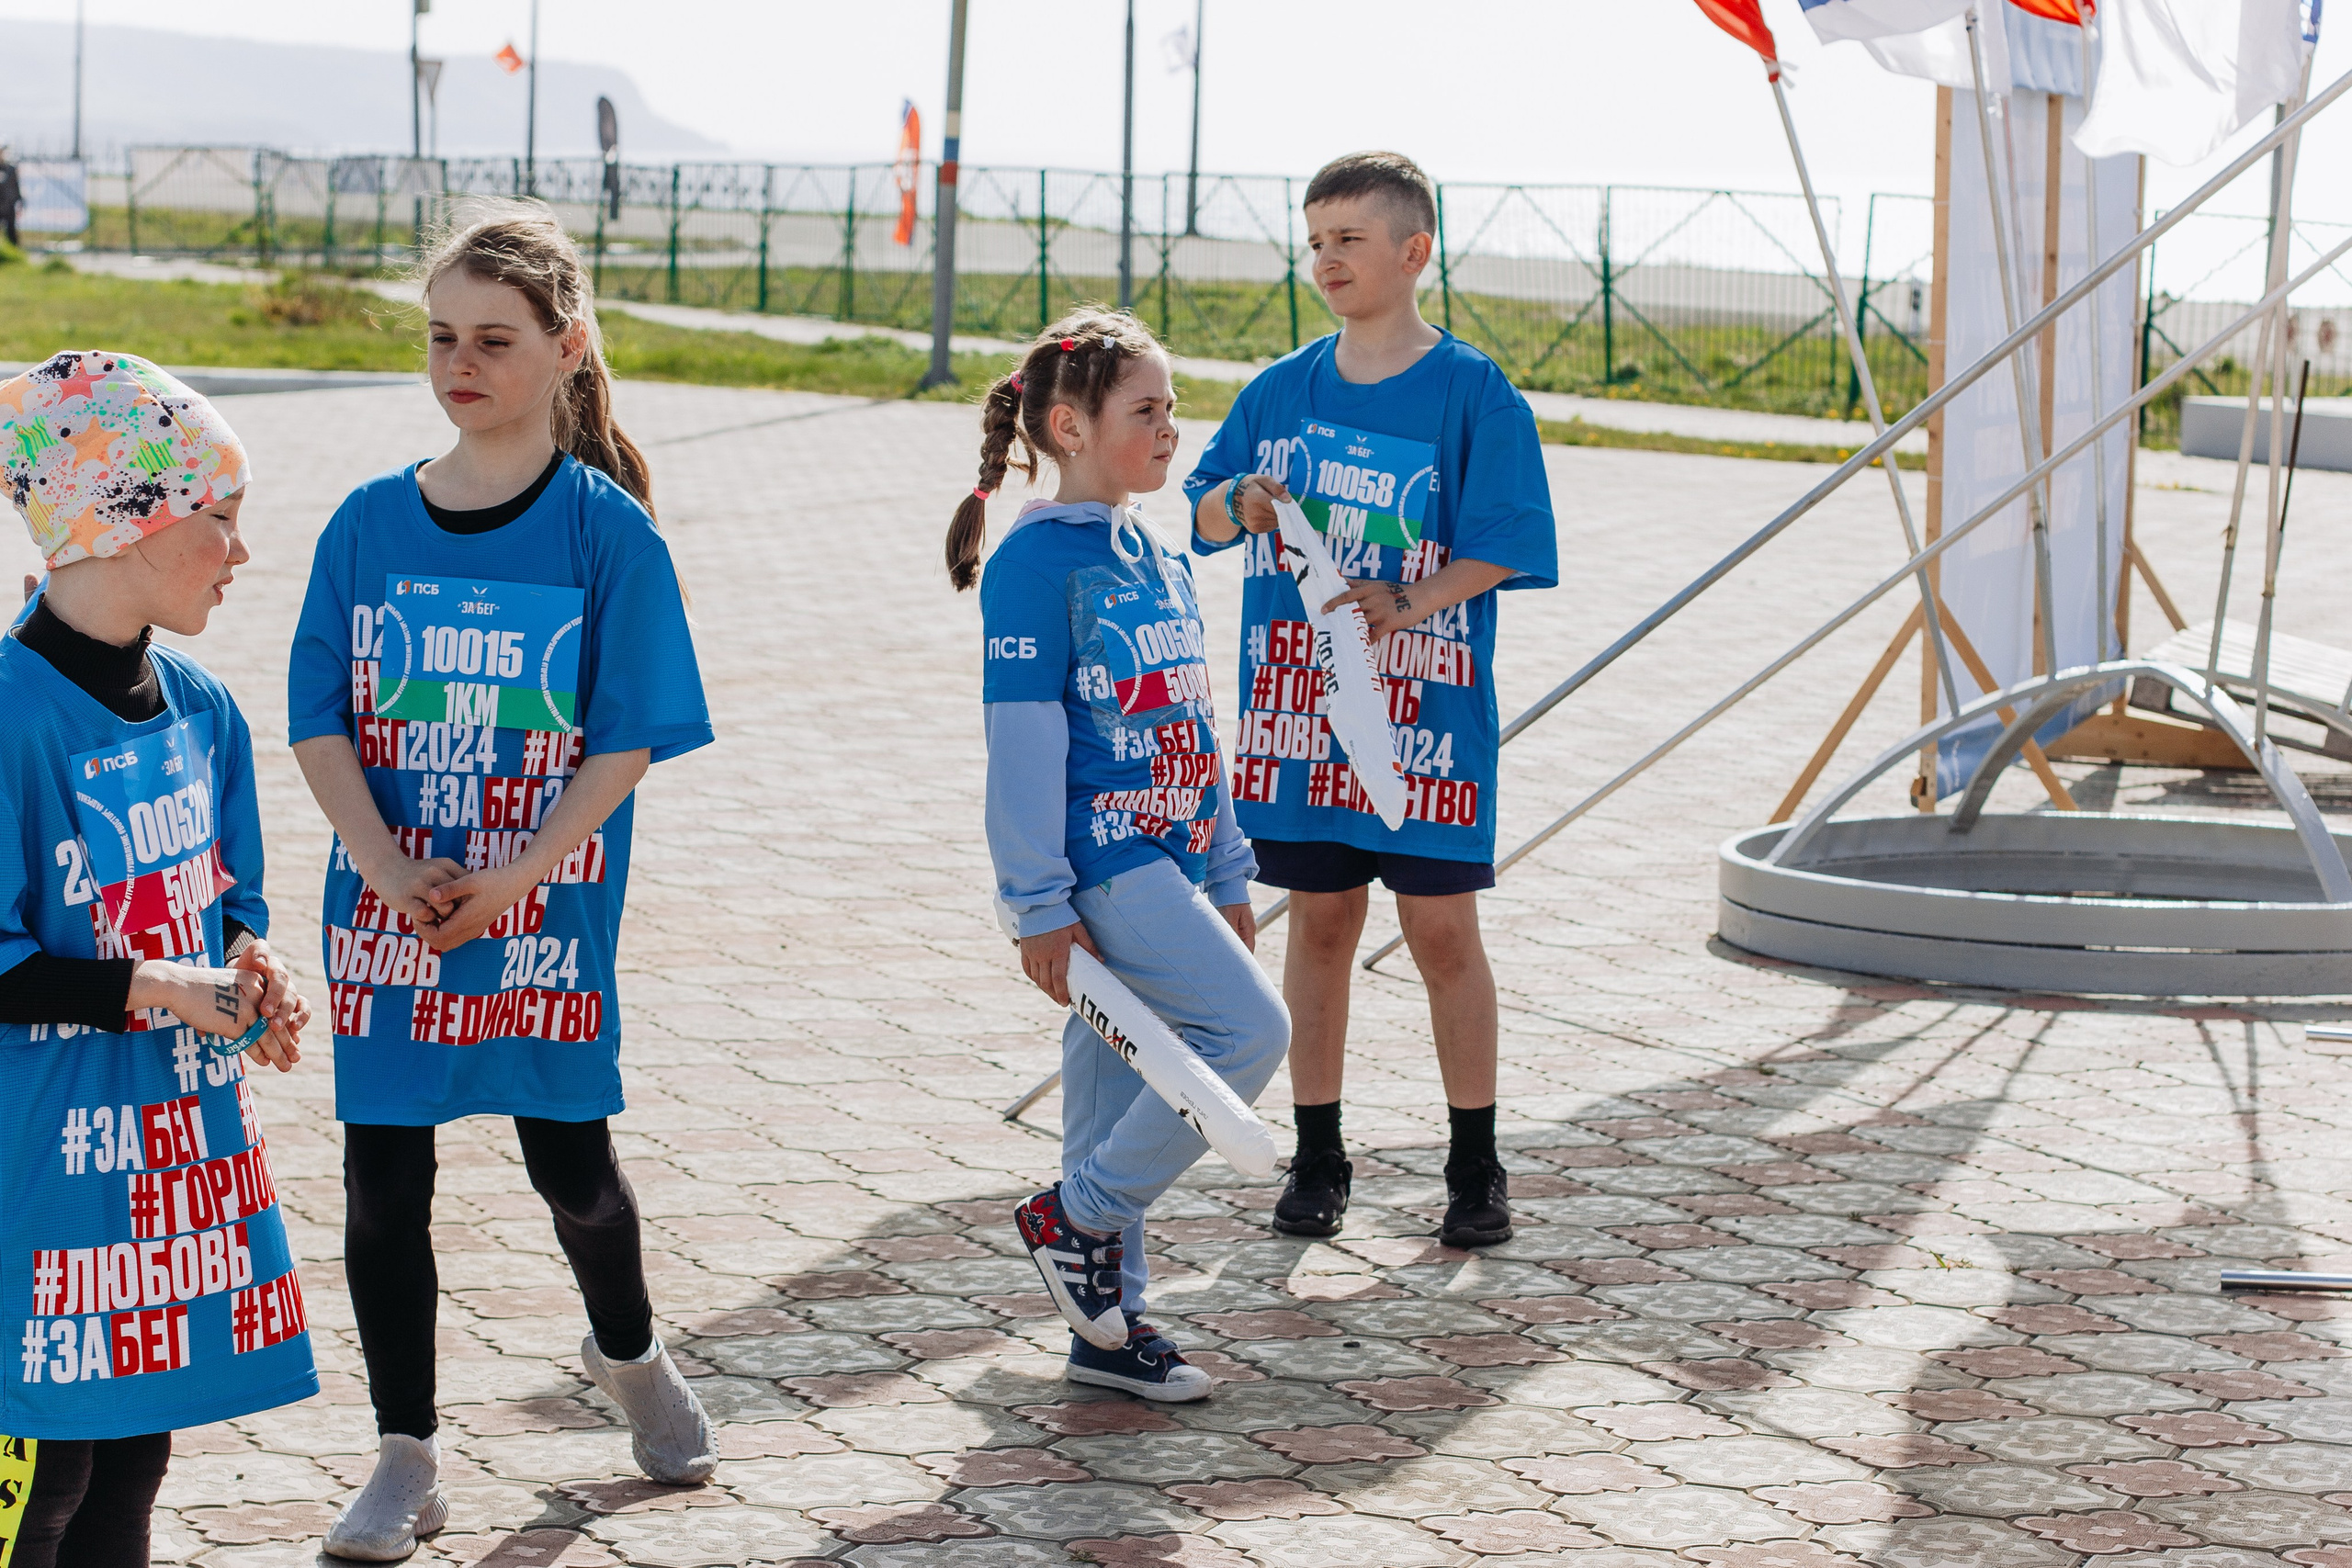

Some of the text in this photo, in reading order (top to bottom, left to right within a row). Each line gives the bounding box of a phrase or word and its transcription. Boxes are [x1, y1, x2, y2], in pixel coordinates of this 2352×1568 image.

[1317, 425, 1335, 438] ПСБ
[1317, 459, 1396, 508] 10058
[1327, 503, 1368, 541] 1КМ
[413, 583, 440, 595] ПСБ
[1118, 590, 1140, 604] ПСБ
[422, 626, 525, 678] 10015
[988, 637, 1037, 660] ПСБ
[444, 682, 500, 727] 1КМ
[103, 750, 138, 773] ПСБ
[1113, 719, 1200, 761] #ЗАБЕГ
[1091, 787, 1205, 823] #ЛЮБОВЬ
[501, 935, 579, 990] 2024
[411, 987, 603, 1046] #ЕДИНСТВО
[61, 1095, 209, 1175] #ЗАБЕГ
[33, 1222, 254, 1316] #ЛЮБОВЬ
[21, 1304, 190, 1384] #ЗАБЕГ
